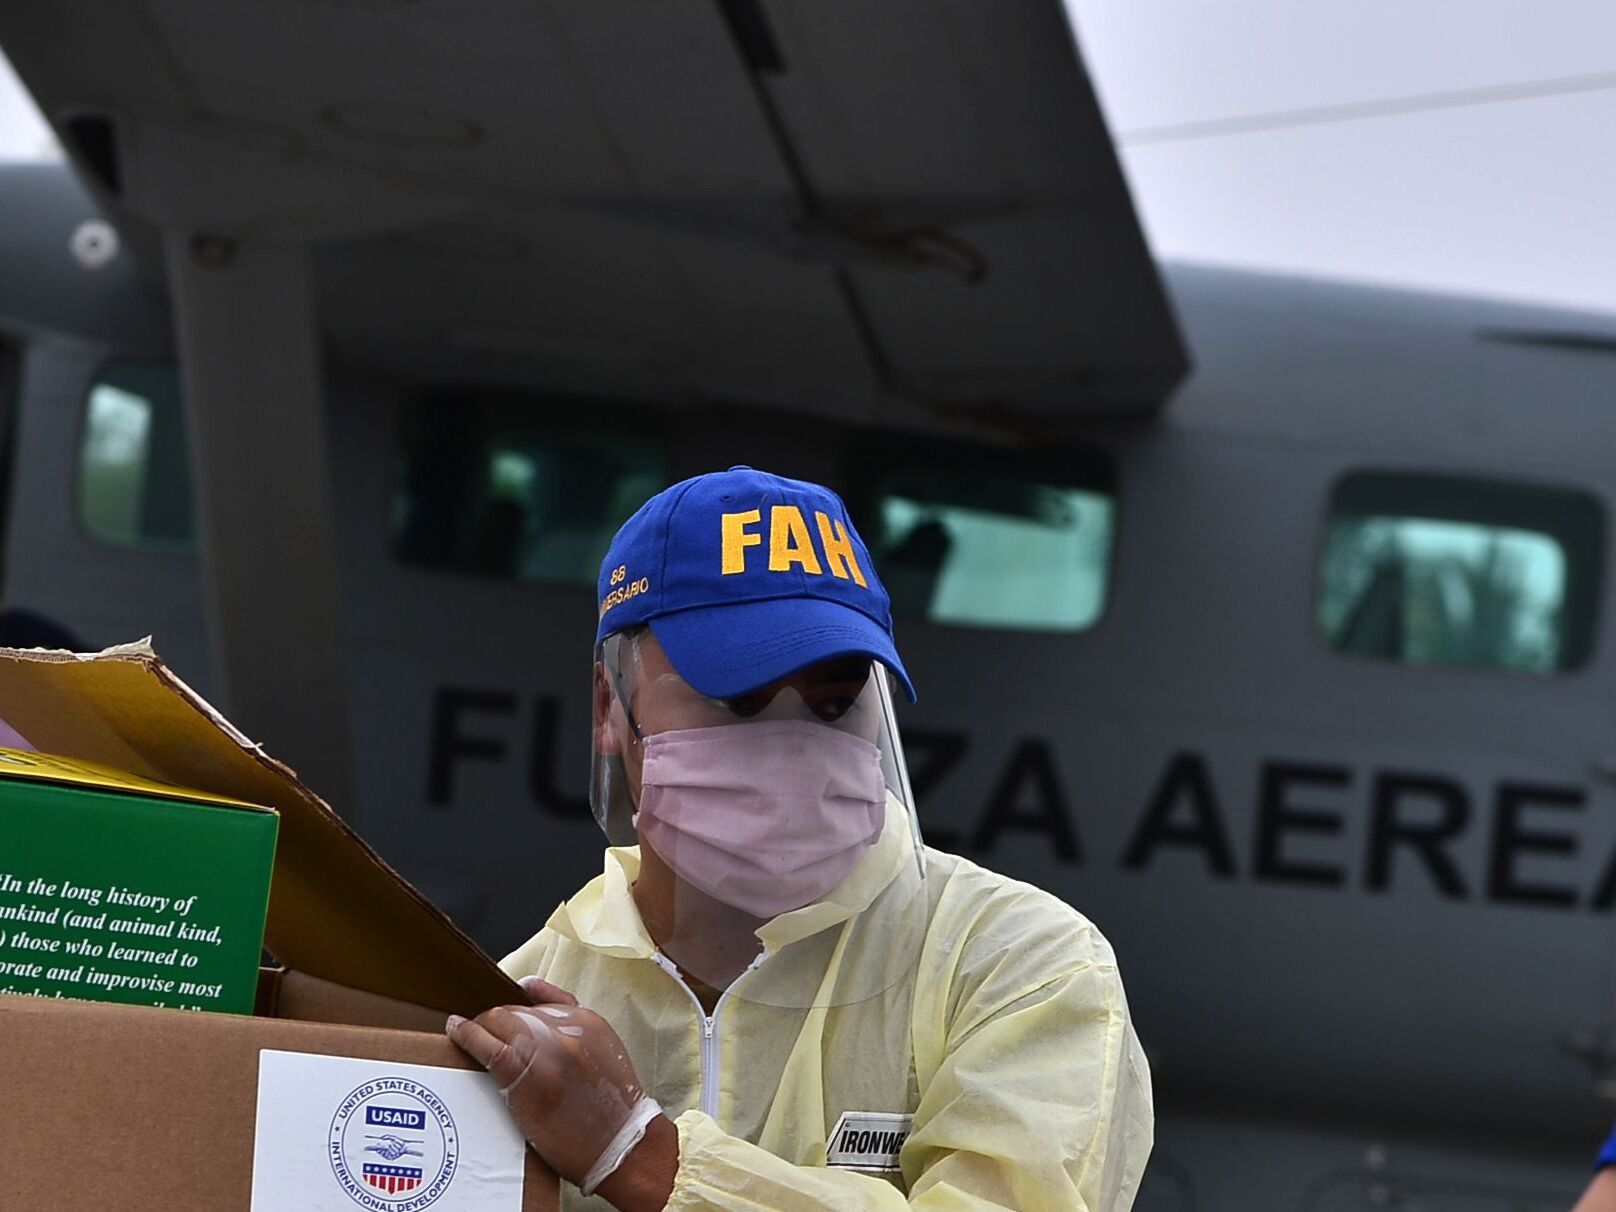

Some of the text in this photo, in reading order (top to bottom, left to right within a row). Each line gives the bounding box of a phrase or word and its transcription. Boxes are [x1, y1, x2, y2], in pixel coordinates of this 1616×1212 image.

[721, 505, 868, 588] FAH
[610, 565, 626, 585] 88
[426, 686, 1616, 912] FUZA AERE
[26, 877, 57, 897] the
[60, 881, 103, 906] long
[106, 886, 170, 914] history
[173, 895, 199, 917] of
[63, 909, 108, 930] (and
[109, 916, 175, 938] animal
[177, 922, 223, 946] kind,
[10, 931, 61, 953] those
[65, 938, 104, 957] who
[107, 941, 179, 966] learned
[180, 952, 199, 968] to
[46, 965, 84, 984] and
[86, 967, 175, 992] improvise
[178, 981, 223, 999] most
[339, 1081, 453, 1129] UNITED STATES AGENCY
[371, 1109, 419, 1126] USAID
[839, 1130, 911, 1154] IRONWE
[332, 1141, 455, 1212] INTERNATIONAL DEVELOPMENT
